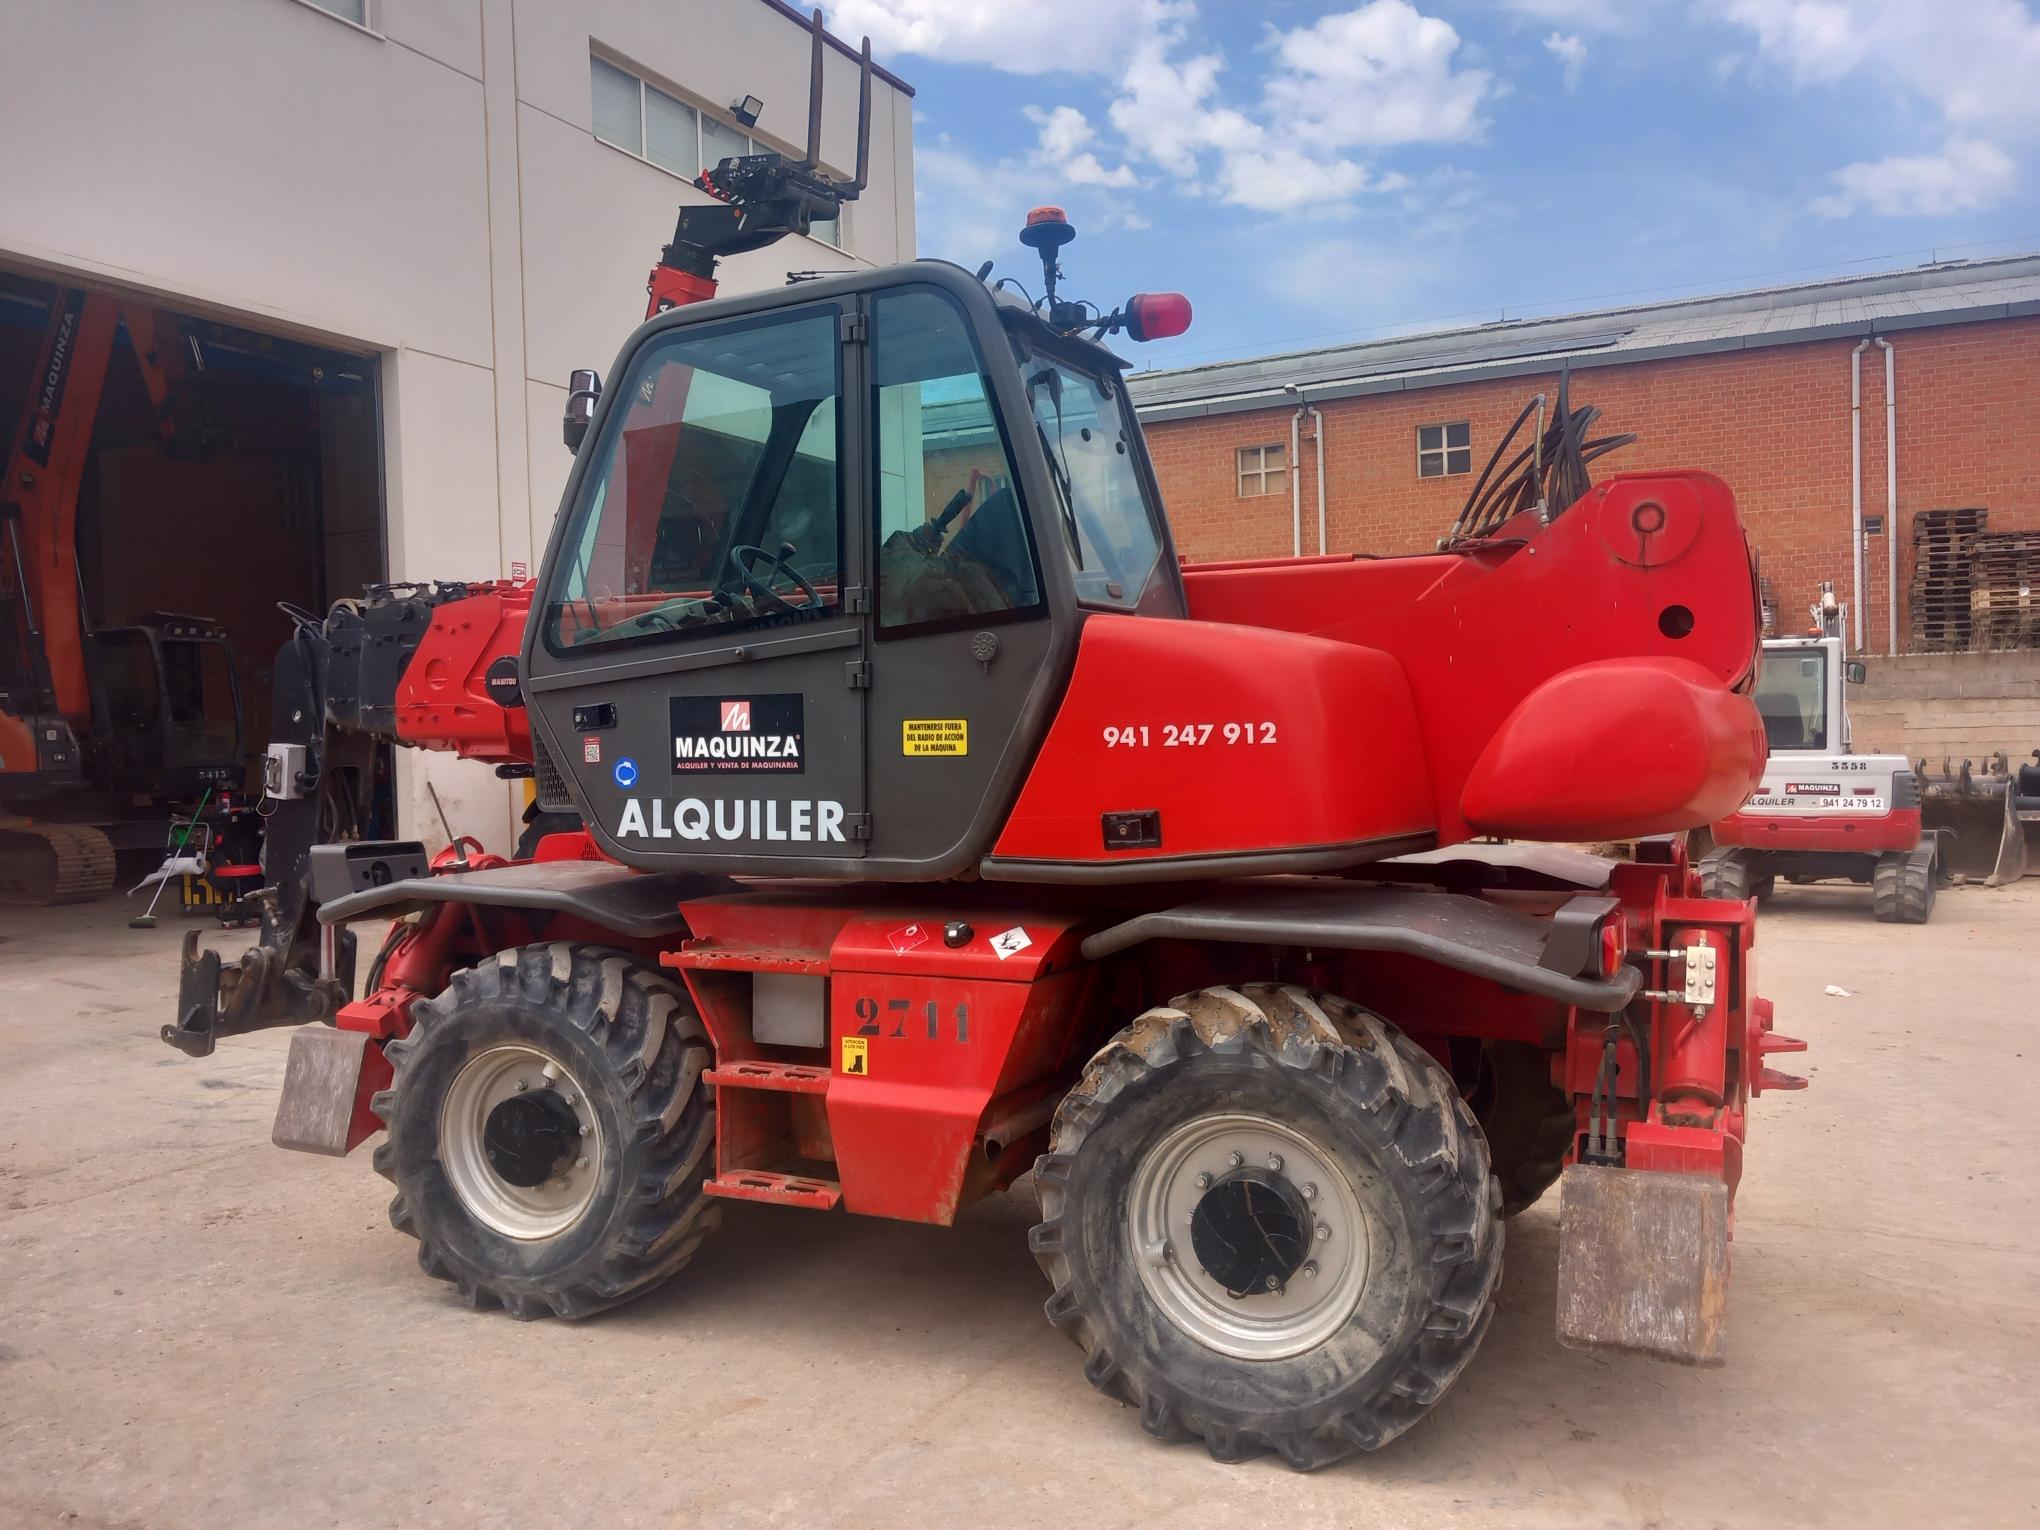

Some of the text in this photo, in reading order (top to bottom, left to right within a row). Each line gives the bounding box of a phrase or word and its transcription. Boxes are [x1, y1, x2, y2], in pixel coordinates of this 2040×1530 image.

[39, 312, 75, 415] MAQUINZA
[491, 678, 516, 686] MANITOU
[908, 723, 962, 731] MANTENERSE FUERA
[906, 733, 916, 741] DEL
[917, 733, 935, 741] RADIO
[936, 733, 943, 741] DE
[1102, 721, 1278, 748] 941 247 912
[675, 735, 799, 759] MAQUINZA
[914, 744, 921, 752] DE
[922, 744, 929, 752] LA
[751, 761, 799, 769] MAQUINARIA
[1798, 784, 1839, 792] MAQUINZA
[1823, 798, 1839, 807] 941
[1842, 798, 1854, 808] 24
[1857, 798, 1868, 808] 79
[1871, 798, 1881, 808] 12
[616, 798, 847, 842] ALQUILER
[855, 998, 969, 1044] 2711
